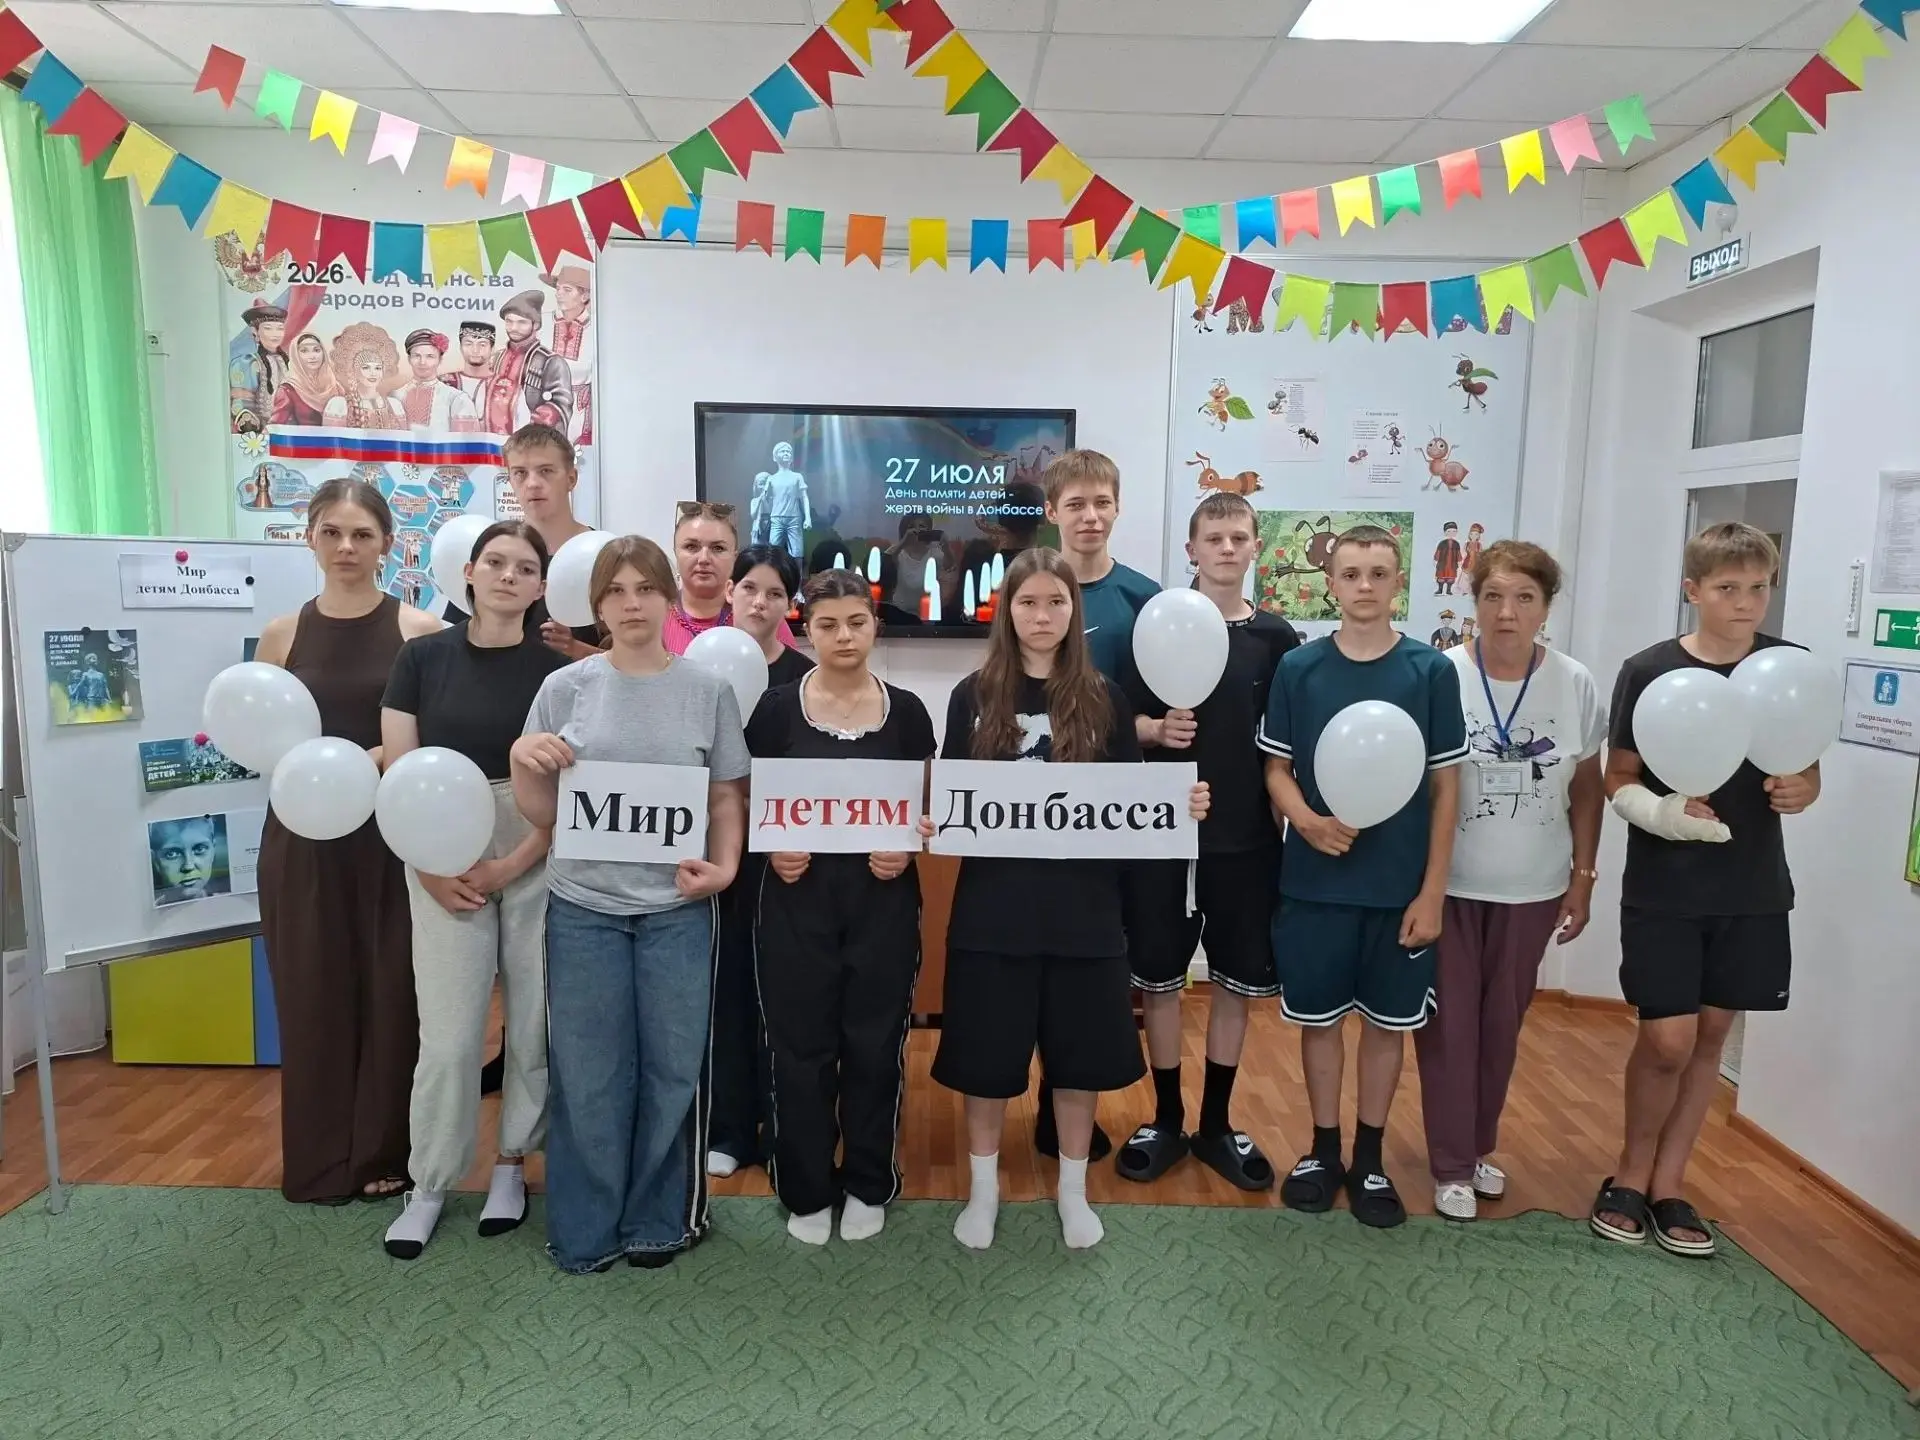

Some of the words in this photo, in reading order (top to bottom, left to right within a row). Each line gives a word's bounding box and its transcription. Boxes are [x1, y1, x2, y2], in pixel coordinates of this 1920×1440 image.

[1692, 243, 1739, 275] ВЫХОД
[319, 292, 404, 310] ародов
[412, 291, 495, 311] России
[885, 457, 920, 483] 27
[885, 487, 917, 499] День
[920, 489, 966, 499] памяти
[969, 487, 1006, 500] детей
[885, 503, 923, 515] жертв
[926, 503, 964, 515] войны
[967, 506, 974, 514] в
[976, 503, 1044, 516] Донбассе
[176, 565, 207, 580] Мир
[136, 584, 176, 595] детям
[180, 583, 240, 596] Донбасса
[49, 634, 58, 643] 27
[568, 790, 694, 846] Мир
[759, 798, 910, 832] детям
[938, 789, 1178, 839] Донбасса
